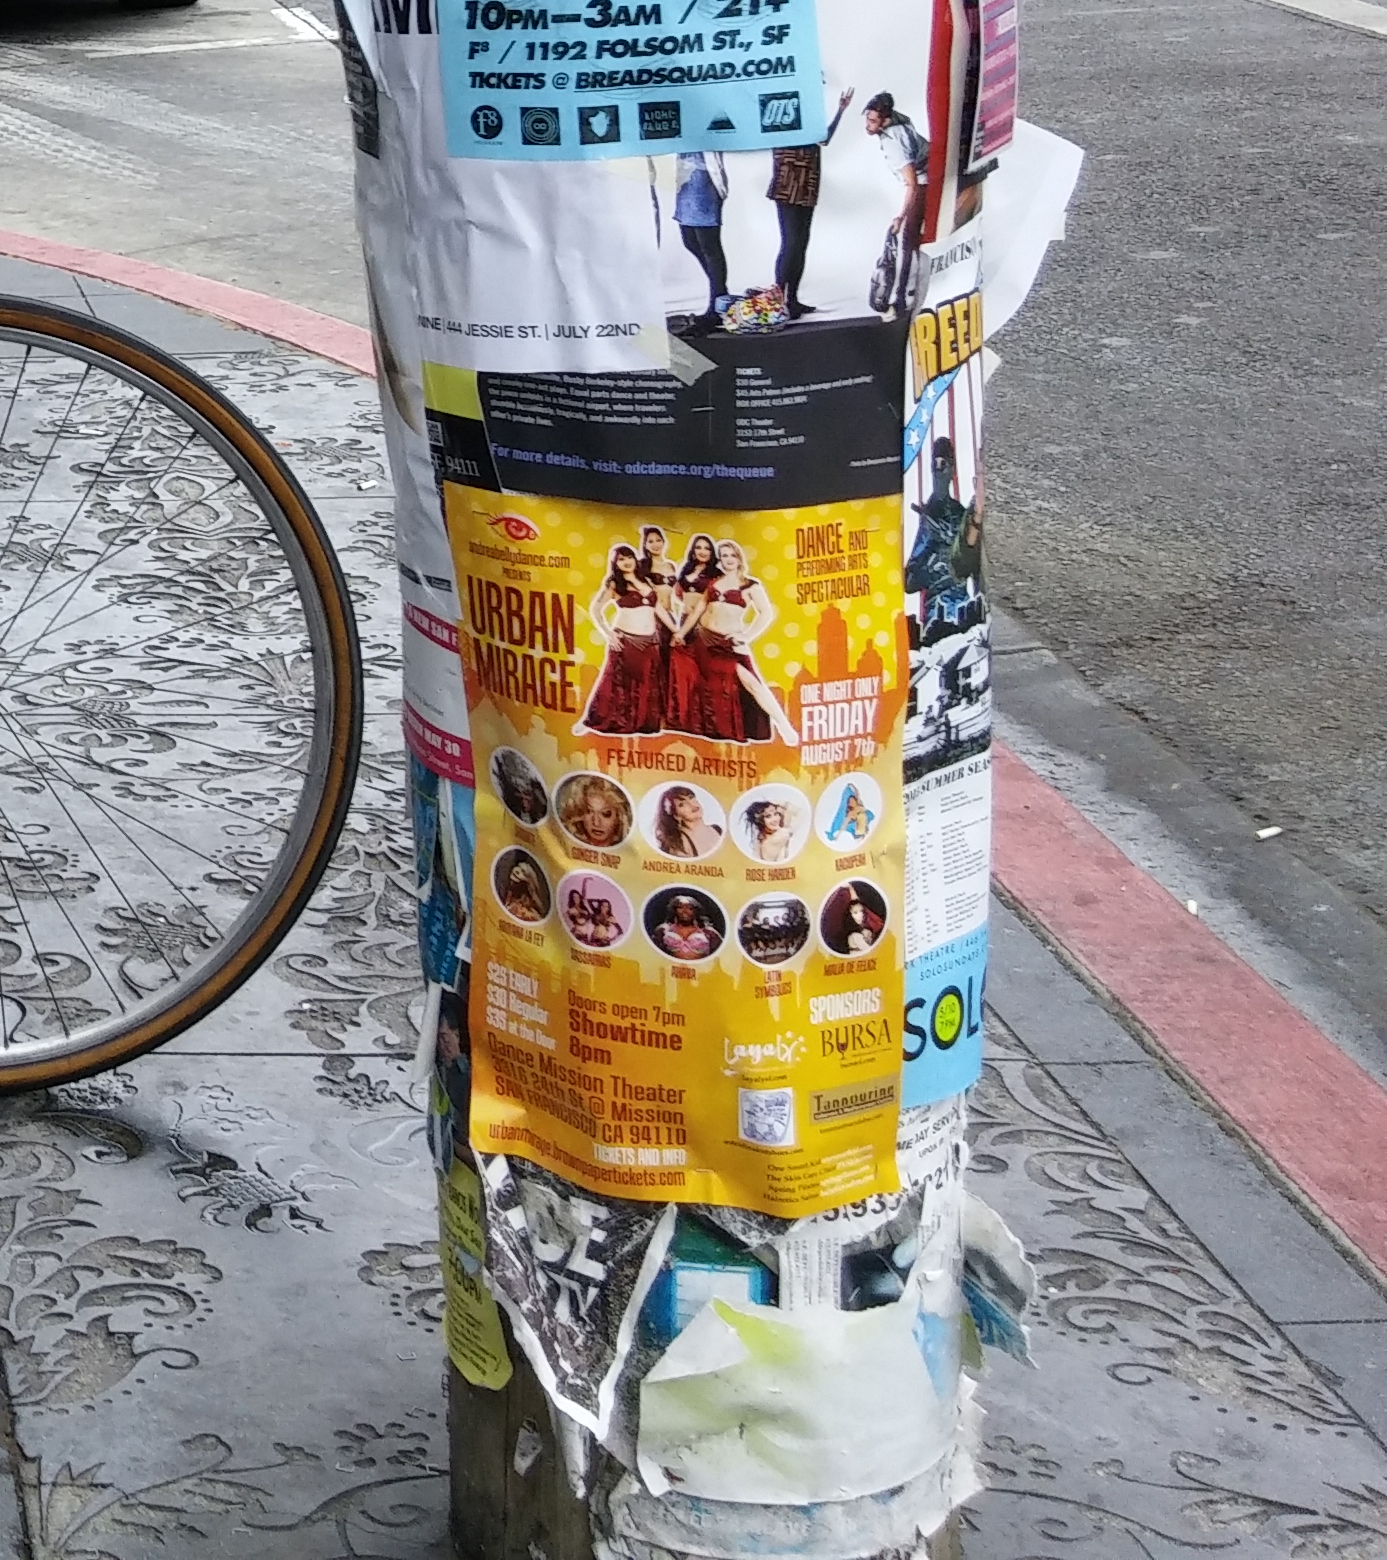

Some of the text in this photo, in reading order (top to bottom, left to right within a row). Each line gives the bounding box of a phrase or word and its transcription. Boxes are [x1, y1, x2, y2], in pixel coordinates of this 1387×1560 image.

[526, 41, 588, 61] 1192
[595, 33, 705, 60] FOLSOM
[762, 24, 791, 46] SF
[468, 71, 546, 90] TICKETS
[575, 55, 796, 91] BREADSQUAD.COM
[464, 322, 641, 339] JESSIE ST. JULY 22ND
[490, 443, 510, 458] For
[512, 449, 543, 464] more
[546, 452, 589, 470] details,
[796, 522, 869, 559] DANCE AND
[796, 552, 869, 579] PERFORMING ARTS
[796, 573, 870, 606] SPECTACULAR
[467, 574, 575, 655] URBAN
[473, 637, 576, 714] MIRAGE
[800, 675, 880, 704] ONE NIGHT ONLY
[801, 698, 877, 743] FRIDAY
[607, 747, 757, 778] FEATURED ARTISTS
[800, 736, 876, 767] AUGUST 7th
[642, 860, 724, 878] ANDREA ARANDA
[486, 984, 507, 1009] $30
[567, 988, 686, 1029] Doors open 7pm
[809, 986, 882, 1025] SPONSORS
[569, 1008, 683, 1052] Showtime
[820, 1017, 892, 1060] BURSA
[569, 1036, 612, 1066] 8pm
[487, 1031, 687, 1106] Dance Mission Theater
[589, 1096, 605, 1120] @
[611, 1101, 685, 1126] Mission
[601, 1121, 624, 1144] CA
[629, 1125, 687, 1146] 94110
[593, 1142, 687, 1165] TICKETS AND INFO
